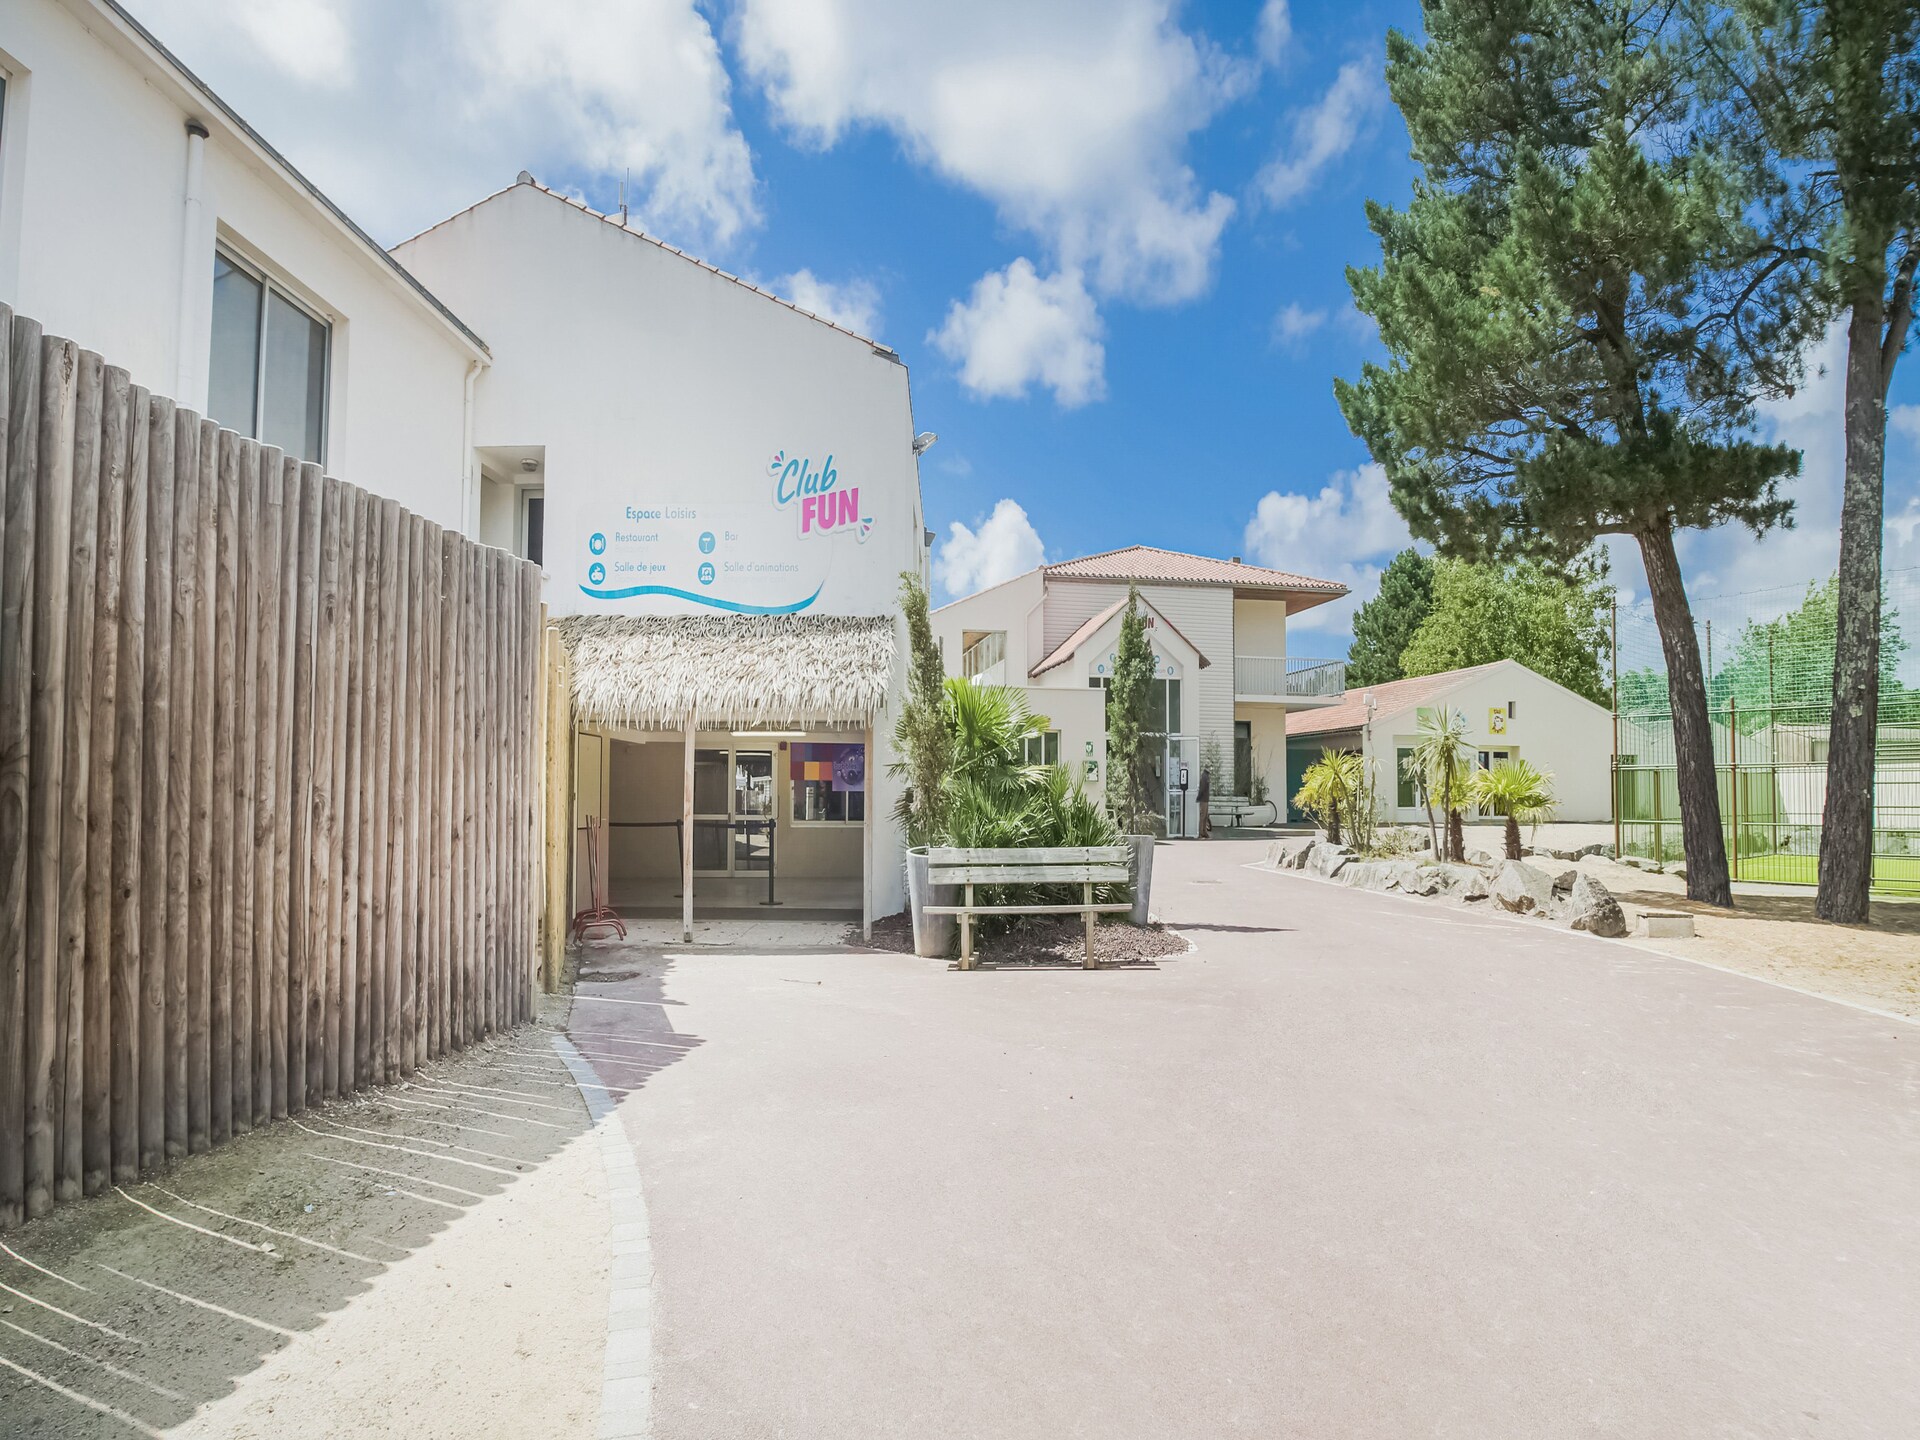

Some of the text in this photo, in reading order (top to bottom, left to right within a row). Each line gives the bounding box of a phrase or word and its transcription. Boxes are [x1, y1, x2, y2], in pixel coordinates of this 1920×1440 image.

[777, 454, 837, 504] Club
[625, 506, 661, 523] Espace
[665, 506, 697, 519] Loisirs
[802, 487, 859, 534] FUN
[615, 532, 659, 543] Restaurant
[724, 531, 738, 541] Bar
[614, 562, 666, 574] Salle de jeux
[724, 562, 745, 572] Salle
